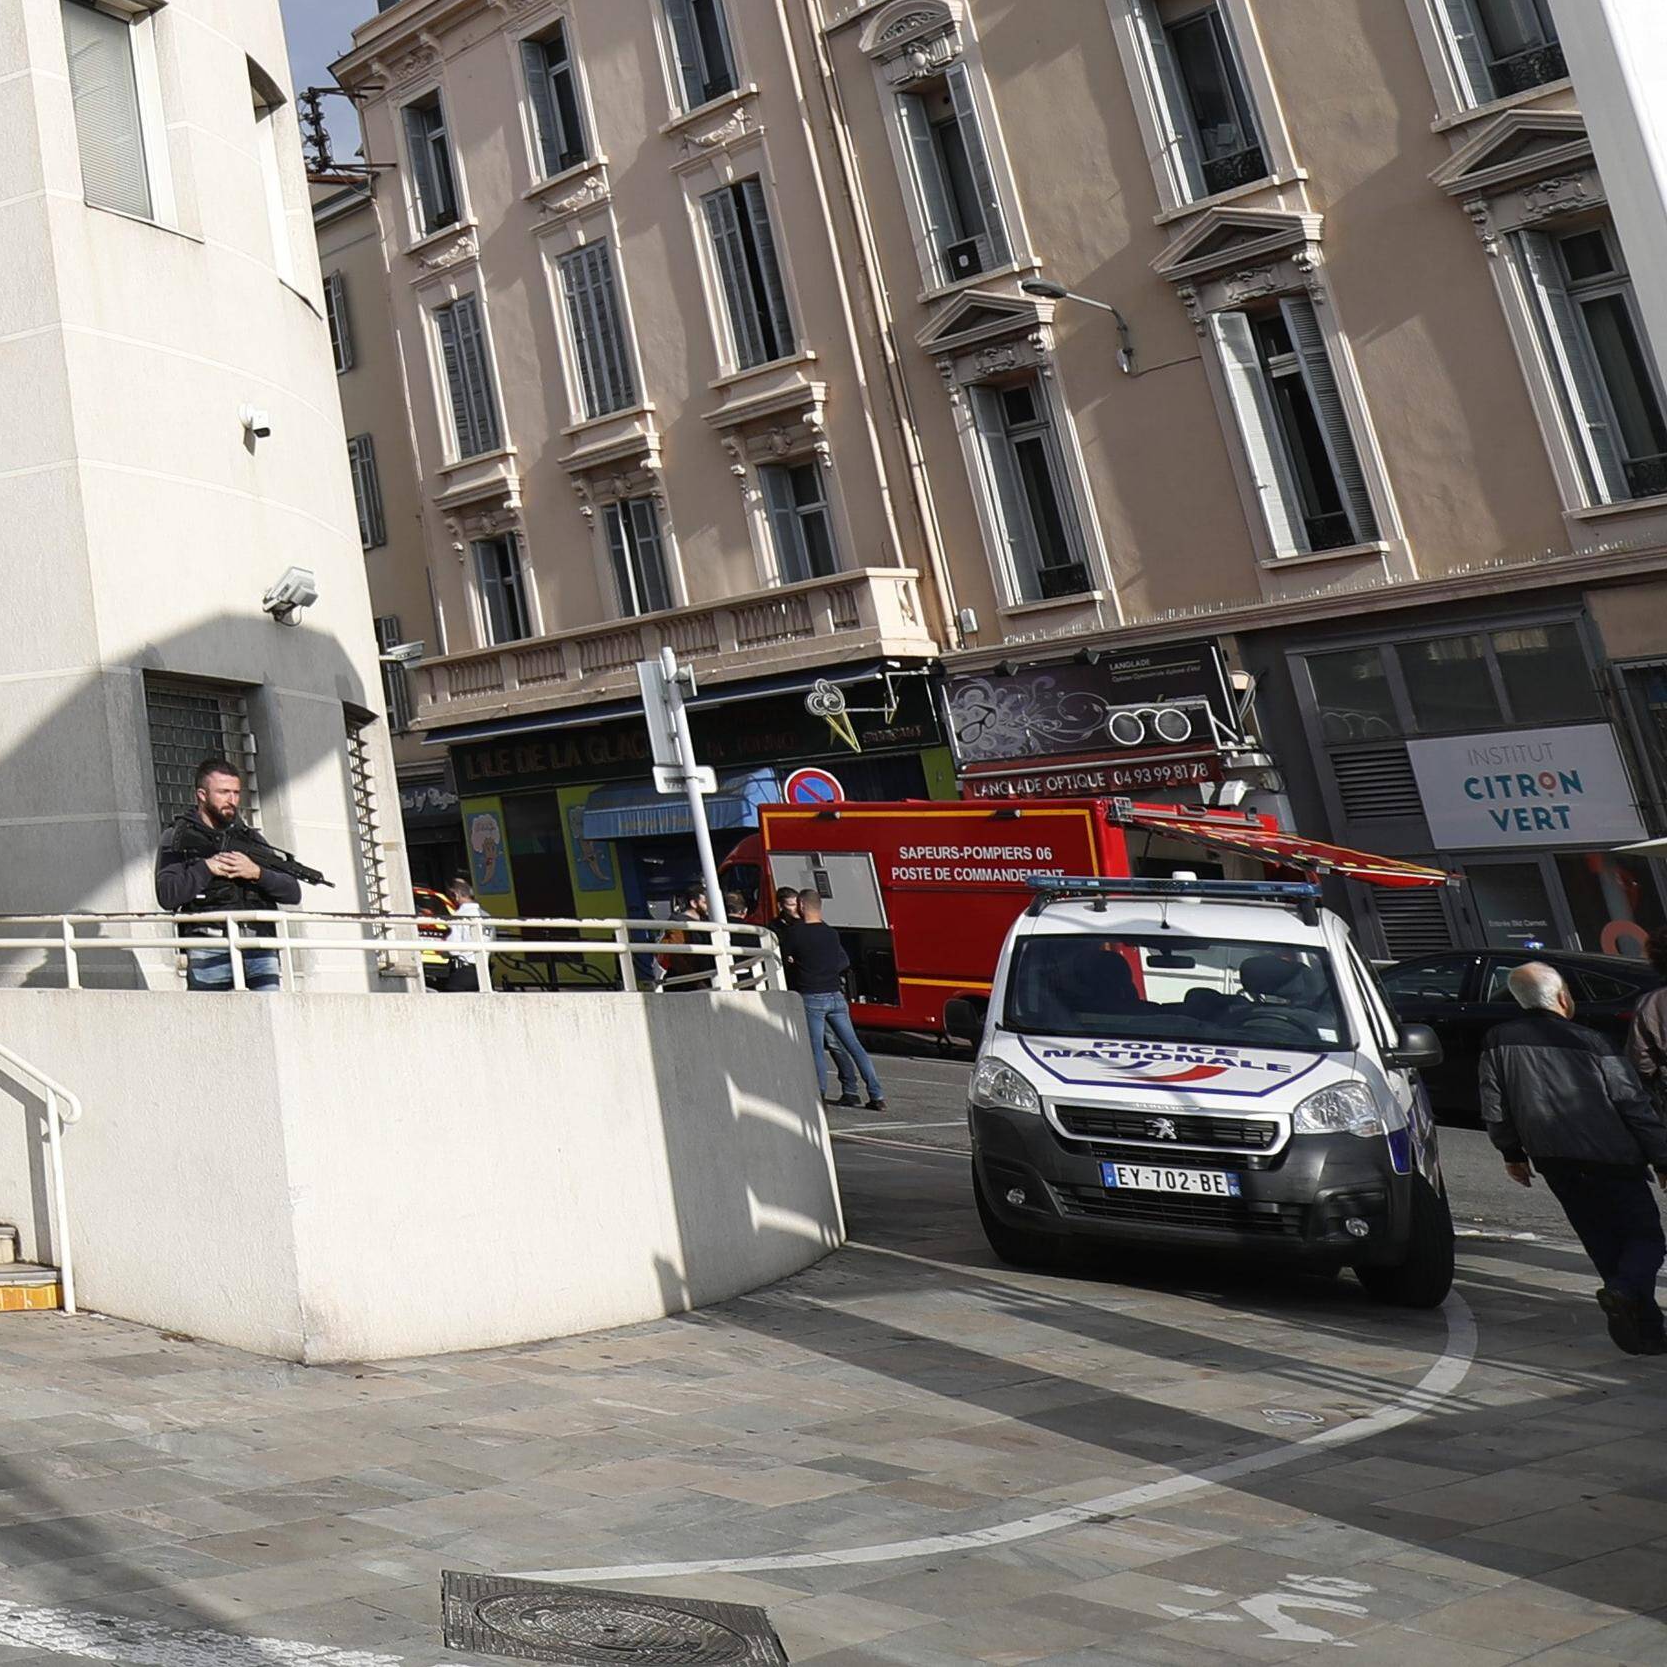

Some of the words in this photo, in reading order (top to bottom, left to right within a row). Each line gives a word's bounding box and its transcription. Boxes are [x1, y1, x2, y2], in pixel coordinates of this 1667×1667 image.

[1467, 742, 1554, 766] INSTITUT
[1046, 772, 1106, 791] OPTIQUE
[1114, 770, 1132, 785] 04
[1134, 768, 1152, 783] 93
[1154, 766, 1171, 781] 99
[1173, 764, 1188, 779] 81
[1190, 762, 1208, 778] 78
[1464, 770, 1584, 800] CITRON
[1488, 805, 1570, 832] VERT
[899, 846, 1033, 860] SAPEURS-POMPIERS
[1036, 847, 1052, 860] 06
[892, 867, 932, 880] POSTE
[935, 868, 950, 880] DE
[1043, 1049, 1292, 1073] NATIONALE
[1092, 1042, 1239, 1057] POLICE
[1117, 1166, 1227, 1194] EY-702-BE
